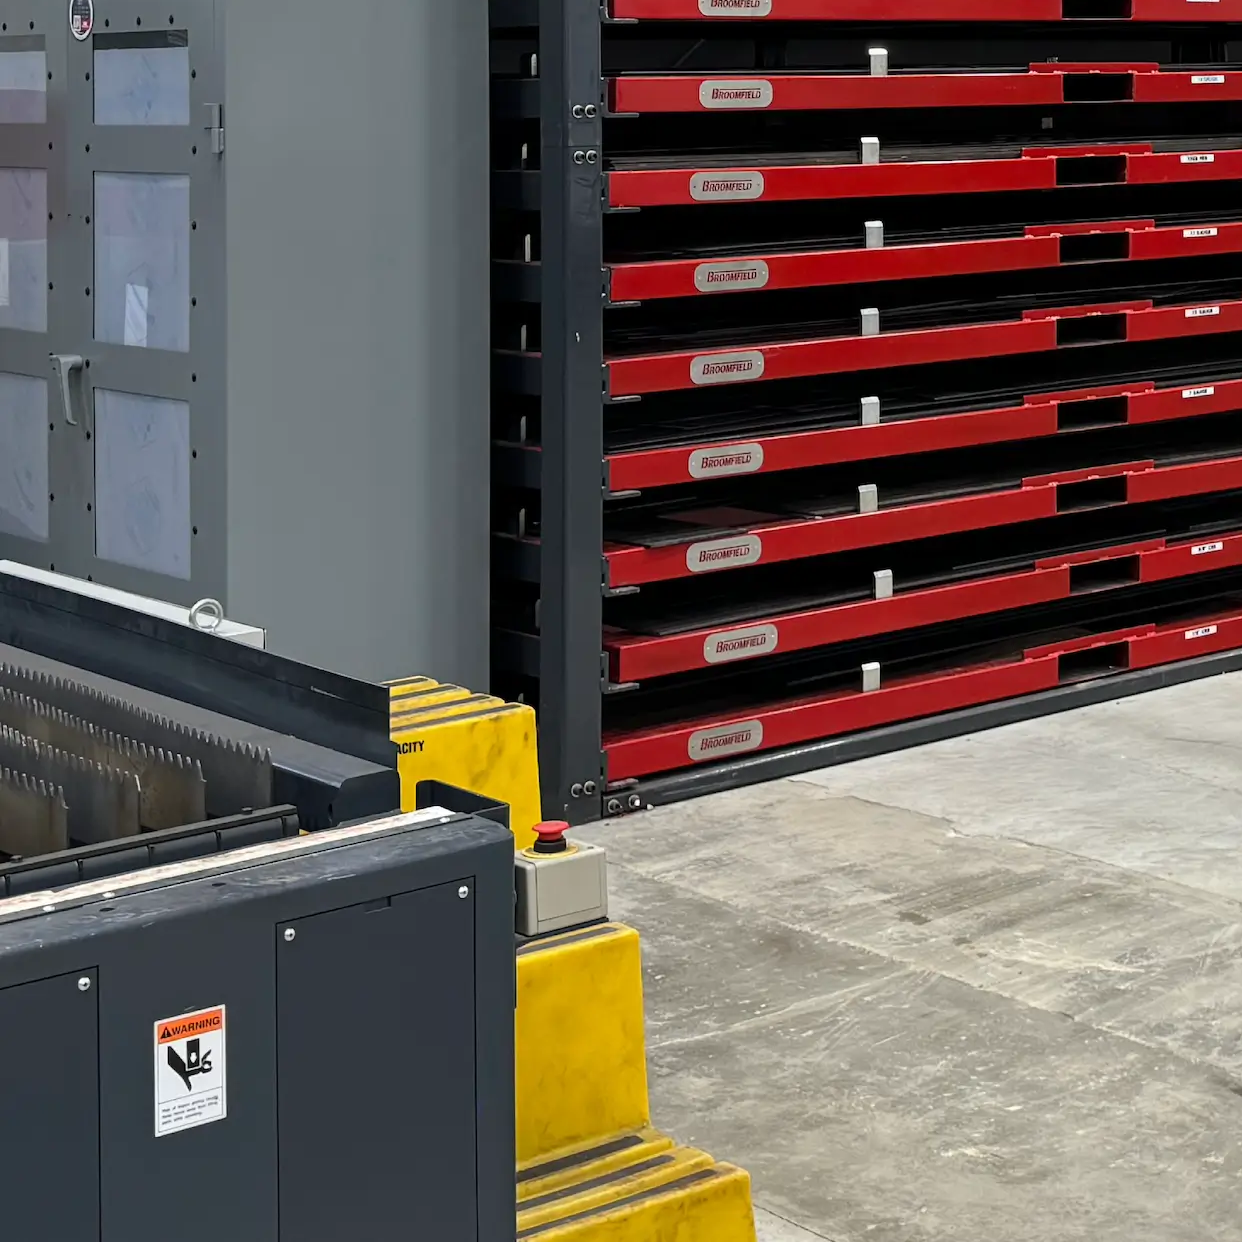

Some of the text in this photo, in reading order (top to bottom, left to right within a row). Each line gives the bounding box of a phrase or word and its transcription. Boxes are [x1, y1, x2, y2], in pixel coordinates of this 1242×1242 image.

[712, 88, 761, 99] BROOMFIELD
[702, 180, 752, 192] BROOMFIELD
[707, 269, 757, 282] BROOMFIELD
[702, 360, 752, 375] BROOMFIELD
[701, 452, 751, 469] BROOMFIELD
[699, 544, 749, 562] BROOMFIELD
[716, 633, 766, 653] BROOMFIELD
[700, 730, 751, 751] BROOMFIELD
[171, 1016, 221, 1036] WARNING
